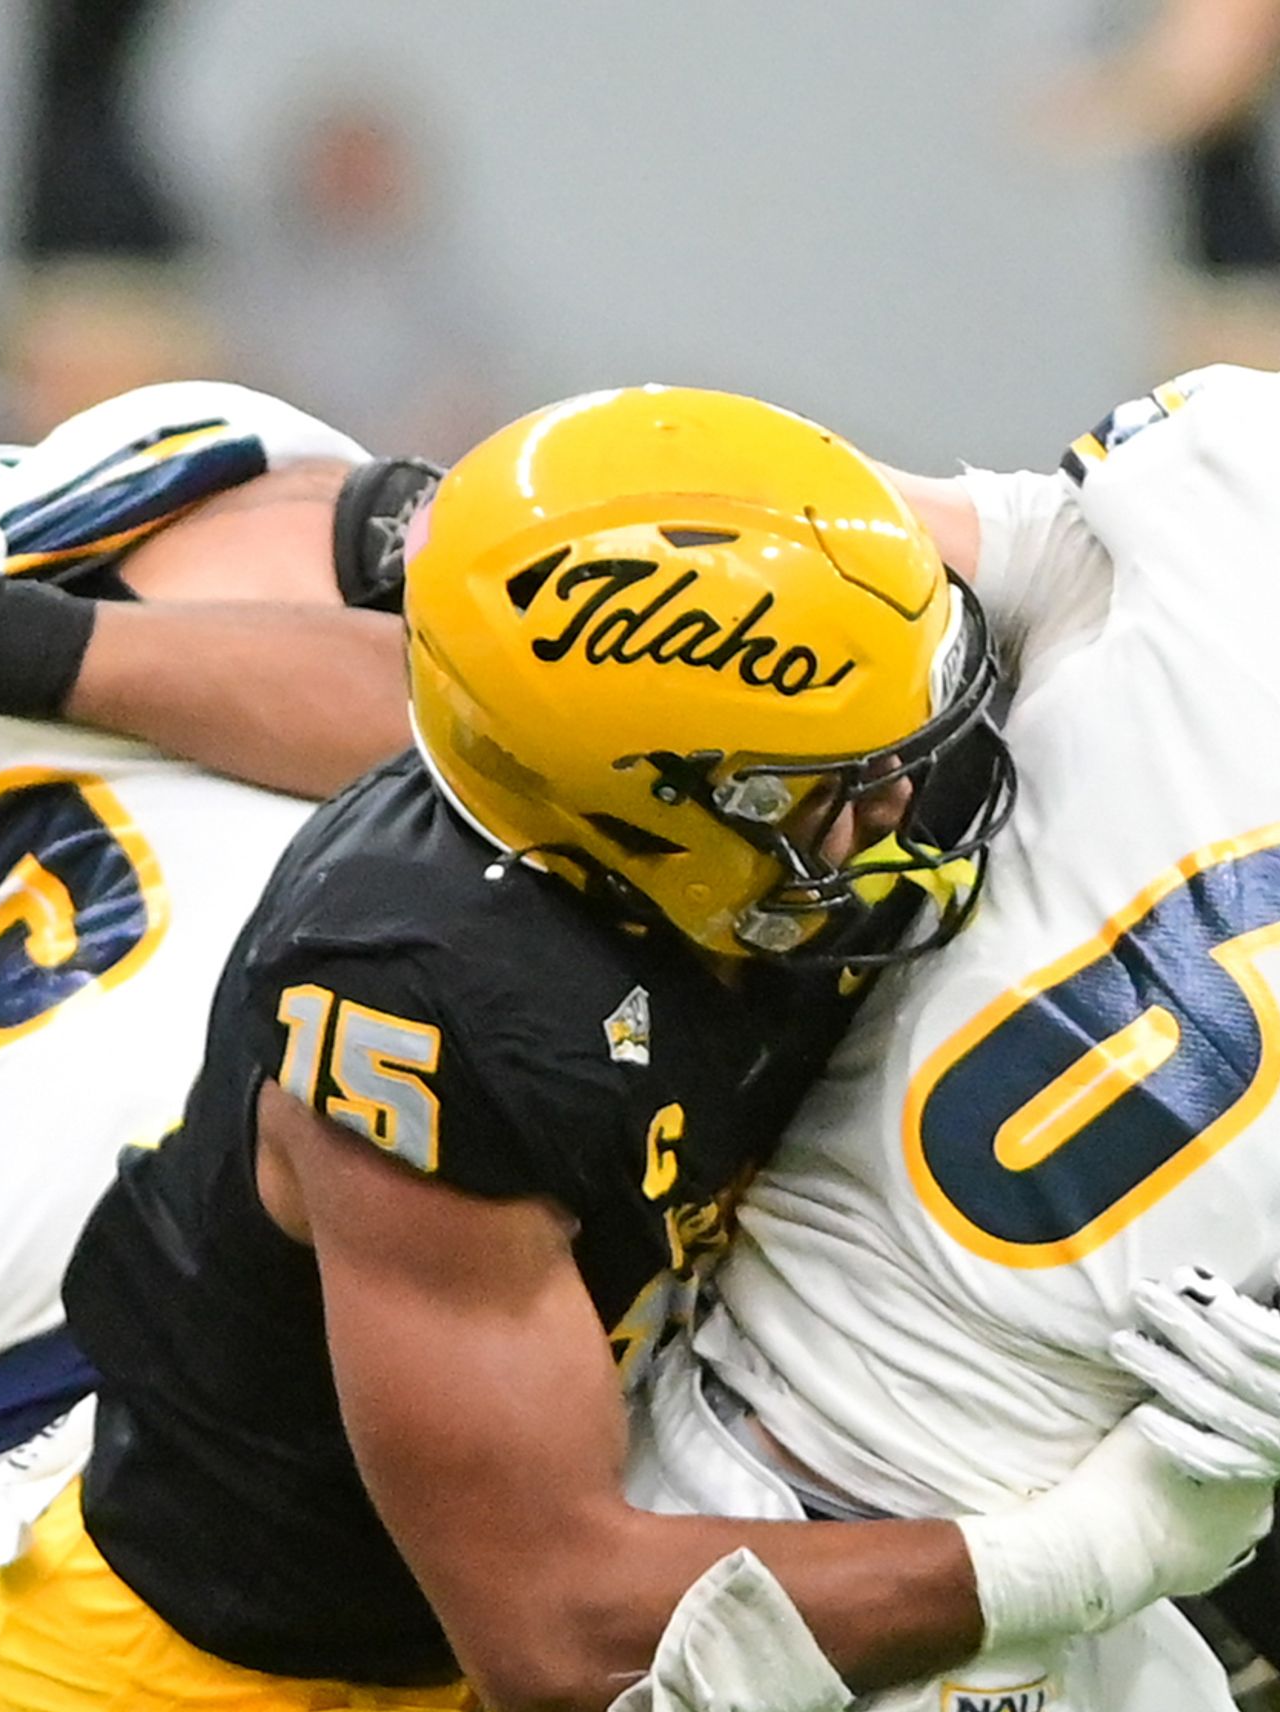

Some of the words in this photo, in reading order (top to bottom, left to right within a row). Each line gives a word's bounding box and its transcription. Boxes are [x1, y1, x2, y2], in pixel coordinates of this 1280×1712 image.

[532, 558, 856, 697] Idaho
[277, 983, 442, 1174] 15
[642, 1102, 685, 1201] C
